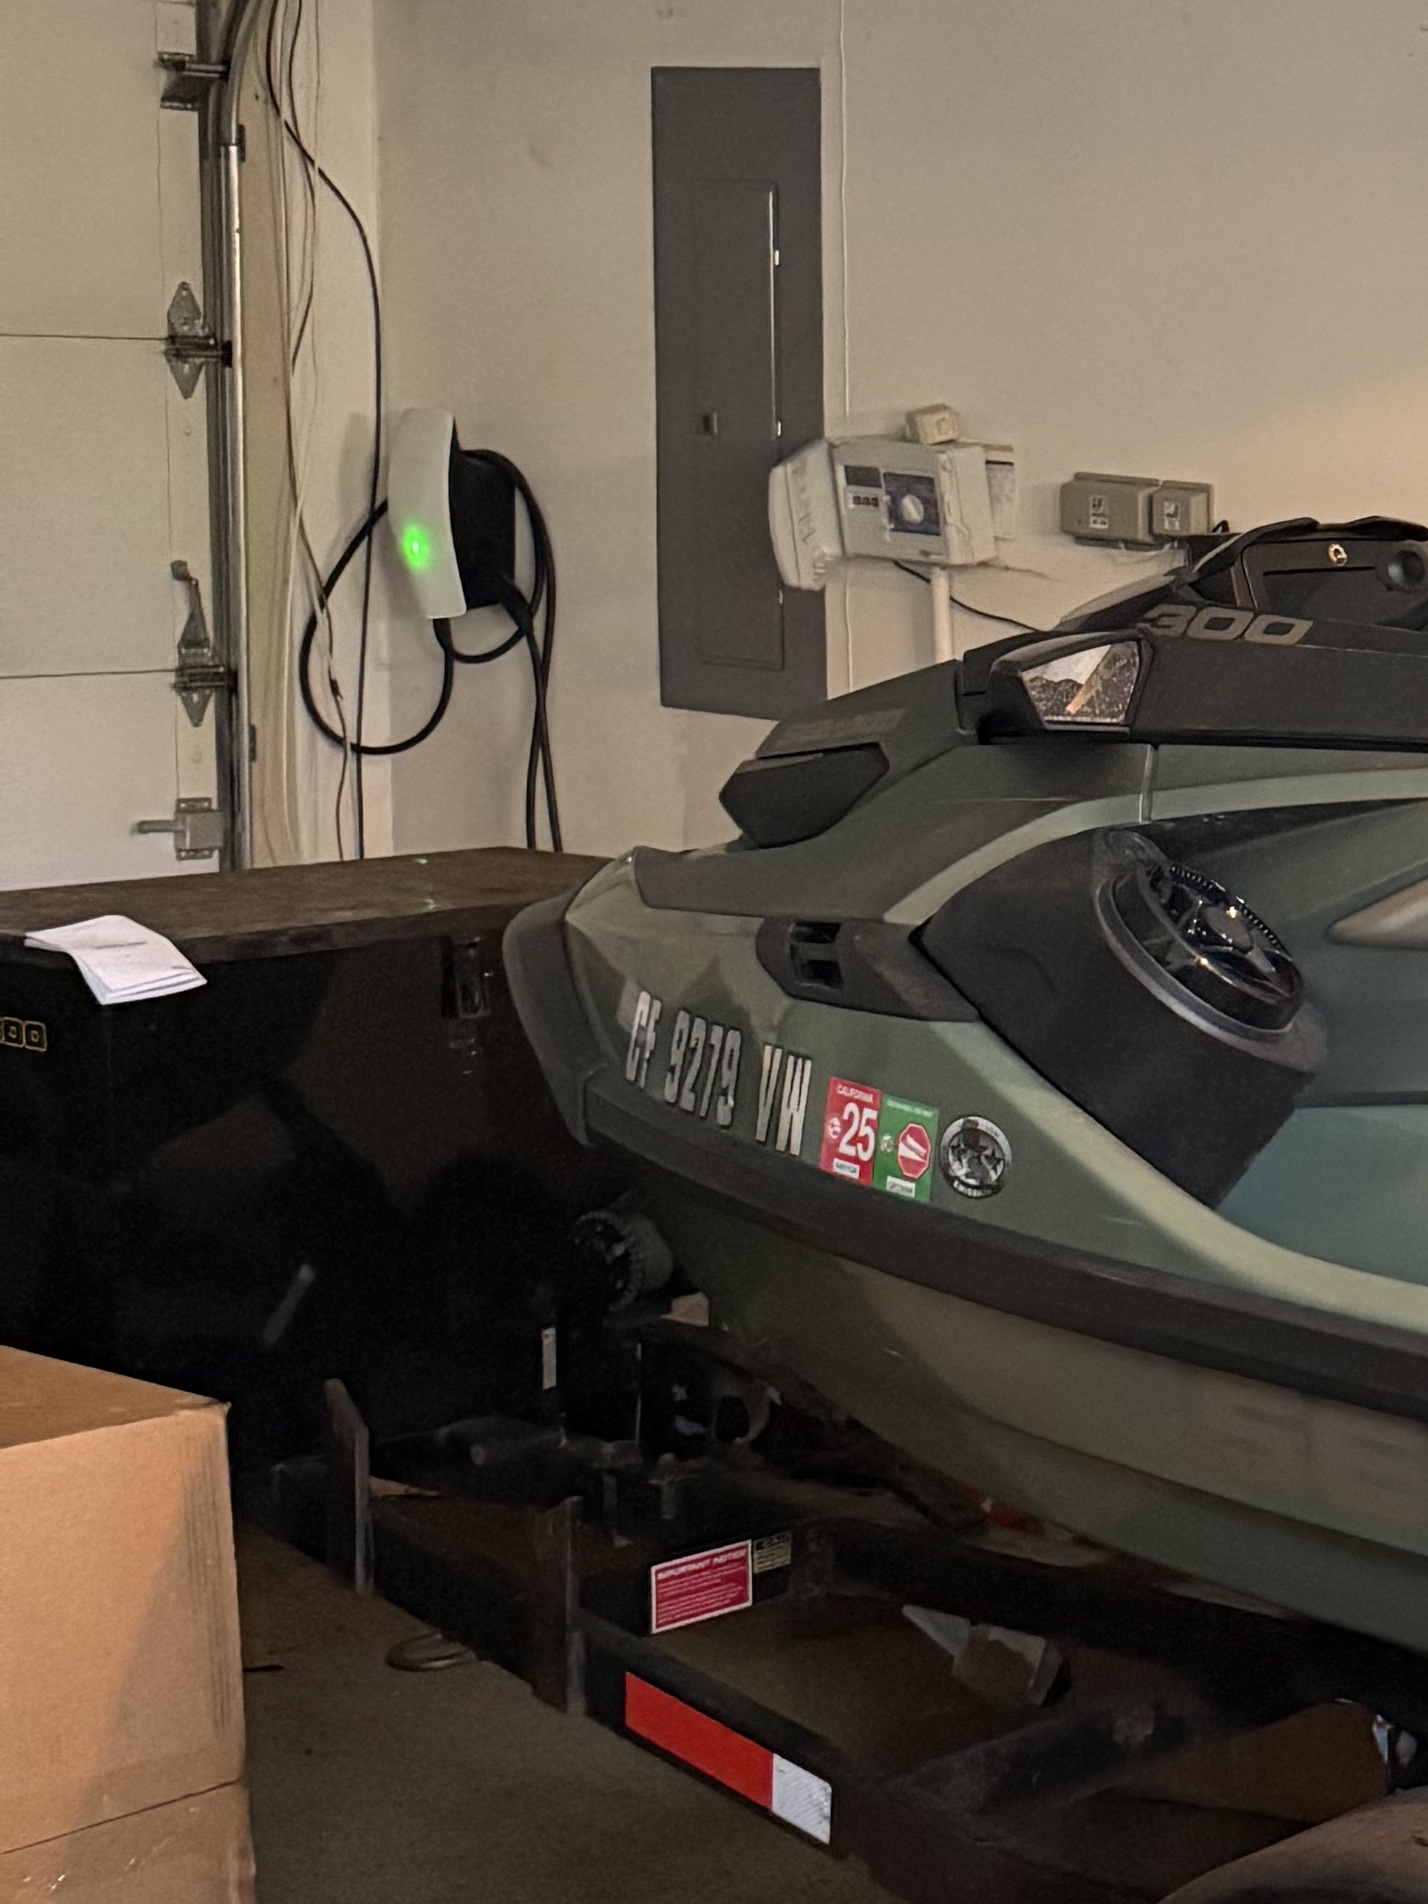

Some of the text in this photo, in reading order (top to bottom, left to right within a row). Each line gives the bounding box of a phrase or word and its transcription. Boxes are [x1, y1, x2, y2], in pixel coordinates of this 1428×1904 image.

[1136, 603, 1314, 646] 300
[626, 991, 662, 1089] CF
[664, 1010, 742, 1127] 9279
[838, 1102, 878, 1162] 25
